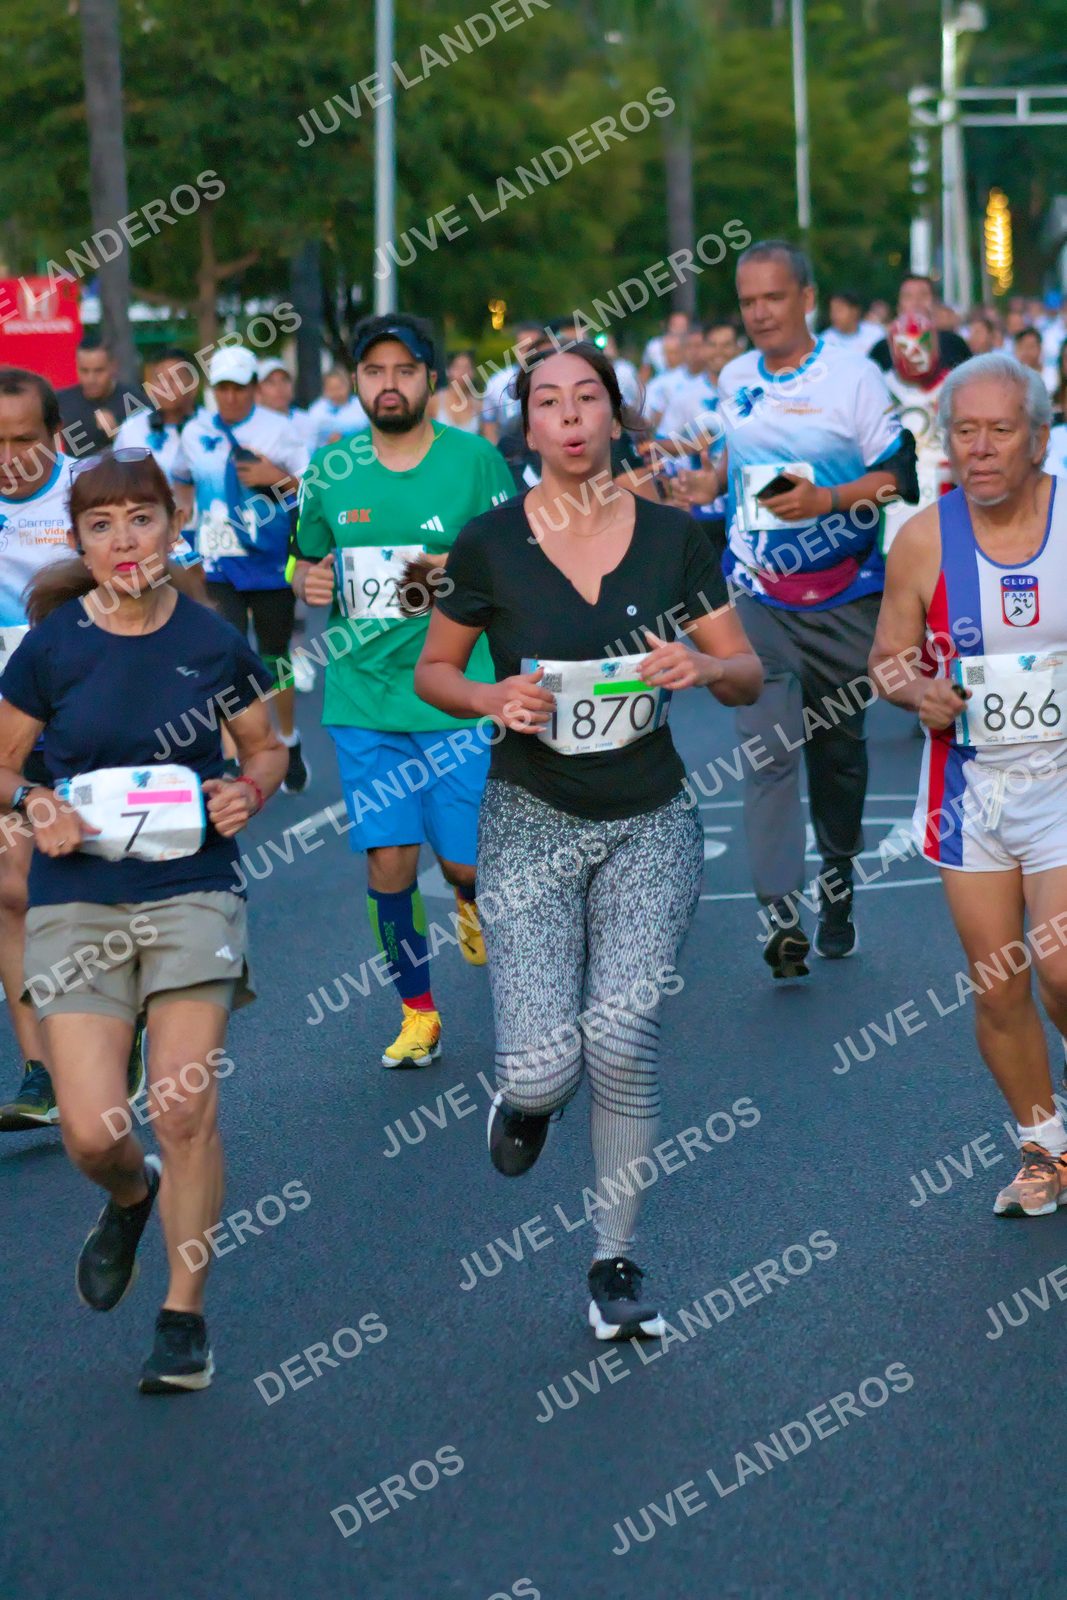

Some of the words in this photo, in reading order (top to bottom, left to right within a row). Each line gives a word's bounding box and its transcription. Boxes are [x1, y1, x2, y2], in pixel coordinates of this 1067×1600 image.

[18, 518, 64, 528] Carrera
[551, 694, 655, 740] 1870
[984, 688, 1061, 732] 866
[120, 811, 151, 852] 7
